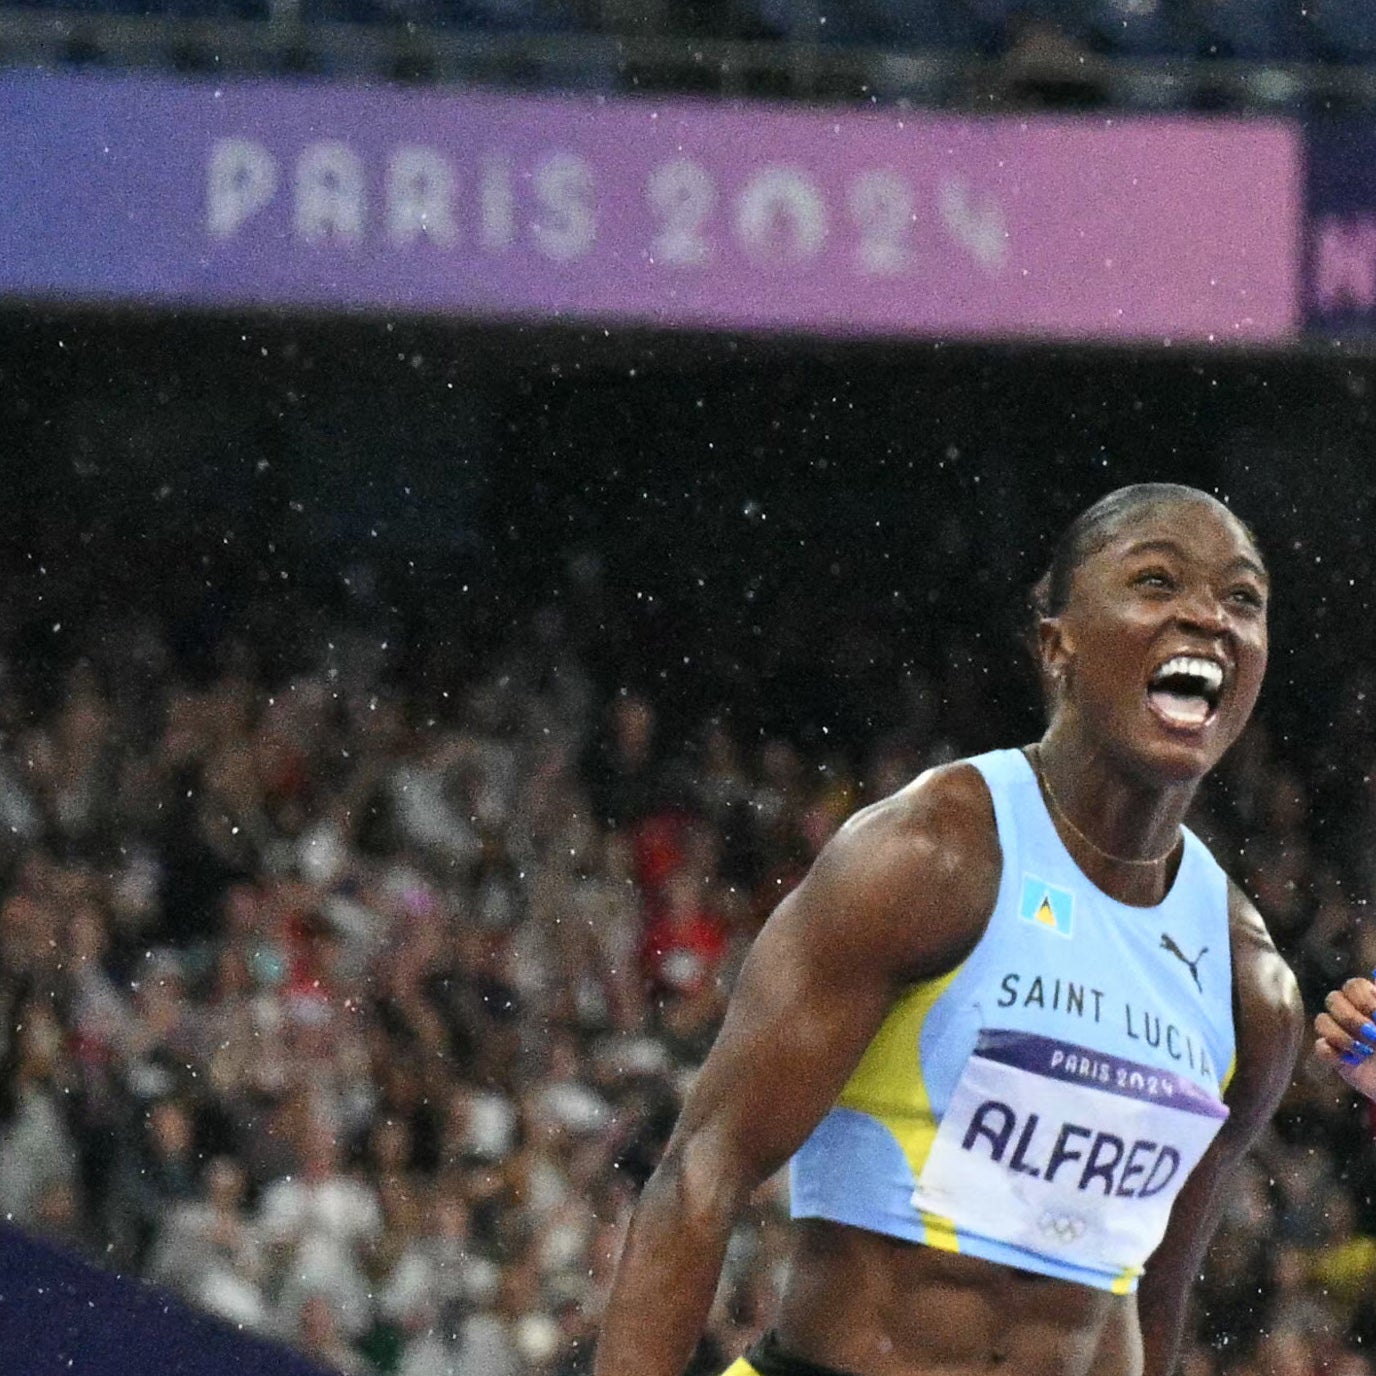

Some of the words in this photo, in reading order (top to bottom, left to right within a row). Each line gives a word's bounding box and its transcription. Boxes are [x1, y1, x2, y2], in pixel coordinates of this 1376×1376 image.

[206, 136, 596, 262] PARIS
[644, 157, 1011, 277] 2024
[996, 972, 1105, 1023] SAINT
[1125, 1002, 1213, 1084] LUCIA
[1050, 1049, 1111, 1083] PARIS
[1114, 1067, 1175, 1097] 2024
[961, 1099, 1182, 1198] ALFRED
